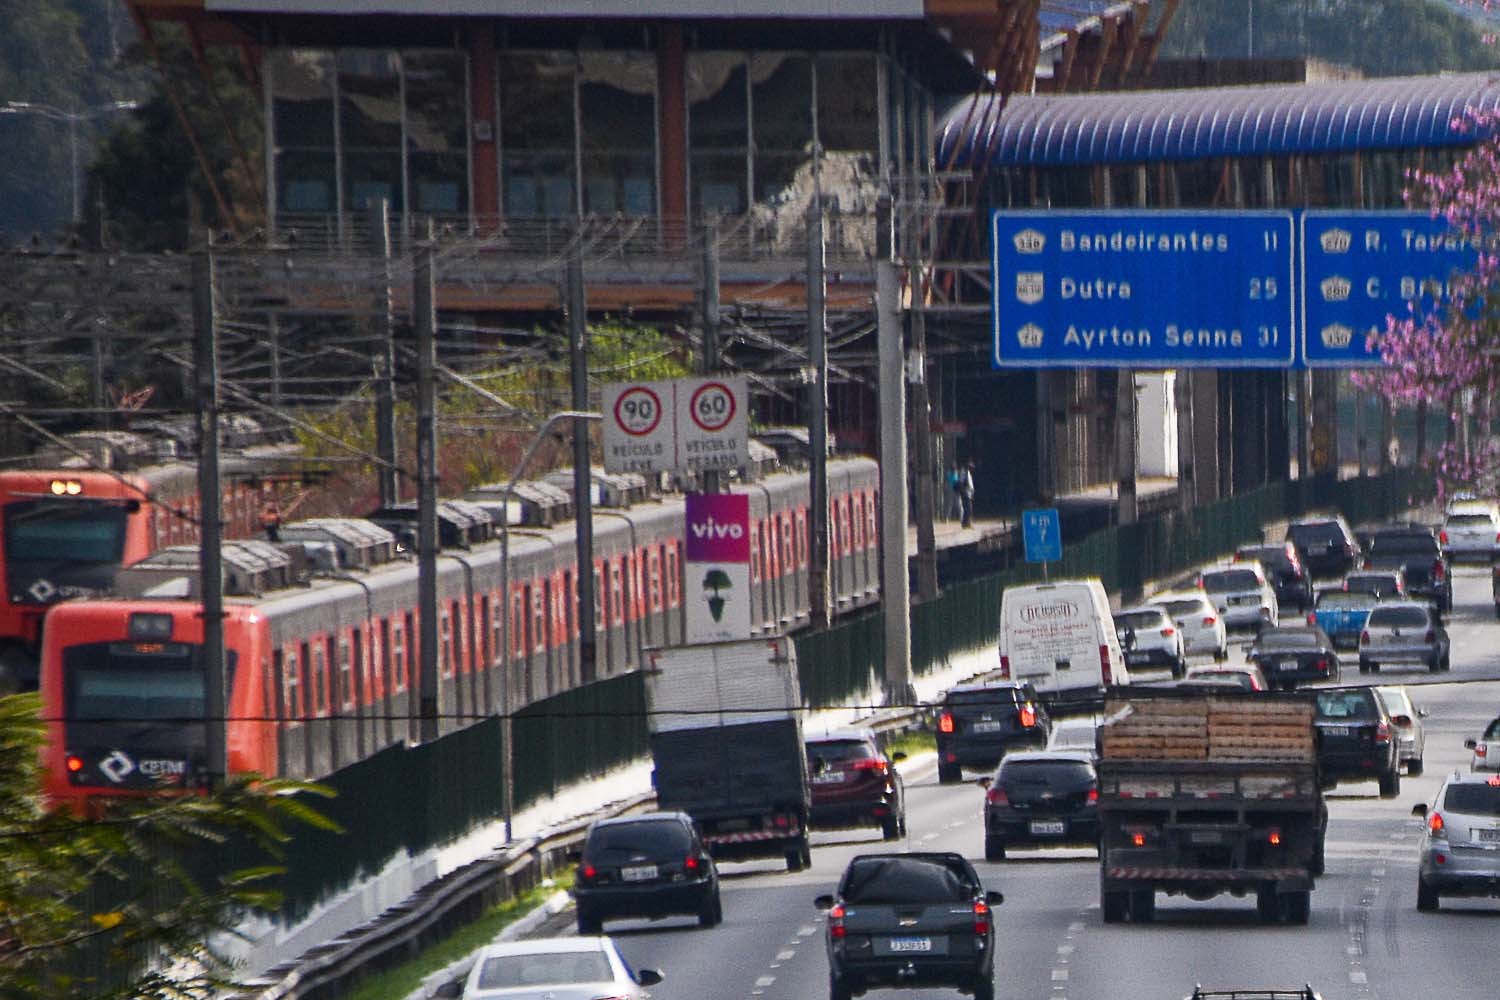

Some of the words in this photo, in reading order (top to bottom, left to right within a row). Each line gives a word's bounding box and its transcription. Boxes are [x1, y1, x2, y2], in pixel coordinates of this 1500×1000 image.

[1061, 229, 1229, 253] Bandeirantes
[1263, 229, 1279, 252] 11
[1365, 230, 1389, 252] R.
[1061, 277, 1132, 300] Dutra
[1366, 277, 1389, 299] C.
[1063, 325, 1152, 351] Ayrton
[1165, 324, 1243, 347] Senna
[1258, 326, 1279, 347] 31
[624, 400, 653, 420] 90
[700, 394, 726, 415] 60
[692, 517, 742, 540] vivo
